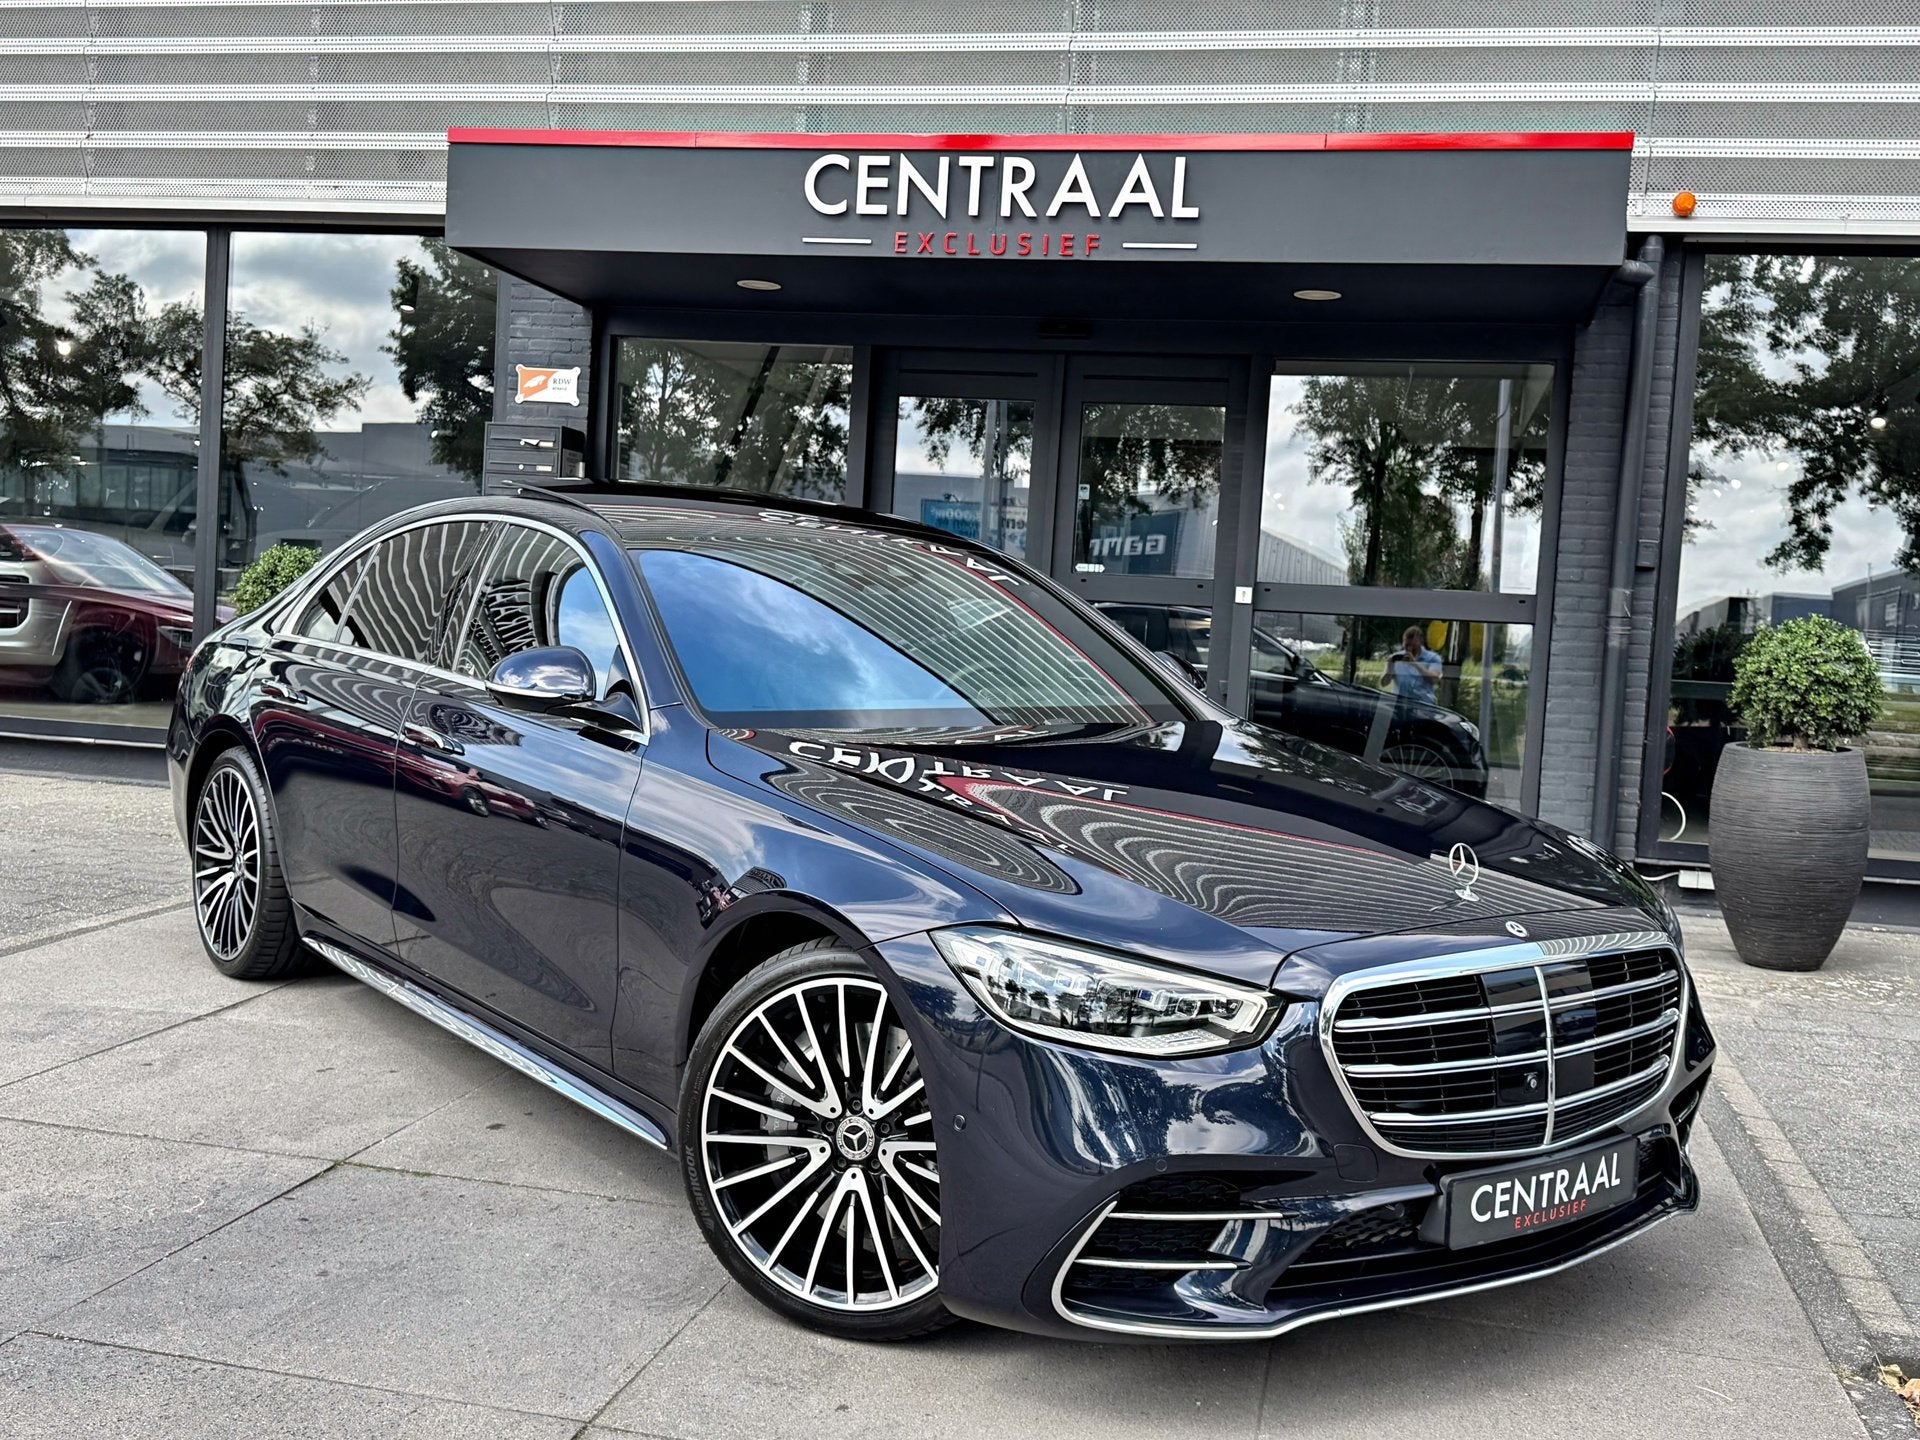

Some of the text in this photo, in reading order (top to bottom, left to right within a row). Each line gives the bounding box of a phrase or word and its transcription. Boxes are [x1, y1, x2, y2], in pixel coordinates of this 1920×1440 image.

[803, 152, 1200, 219] CENTRAAL
[893, 231, 1101, 257] EXCLUSIEF
[552, 377, 572, 386] RDW
[1470, 1152, 1621, 1223] CENTRAAL
[1513, 1198, 1588, 1230] EXCLUSIEF
